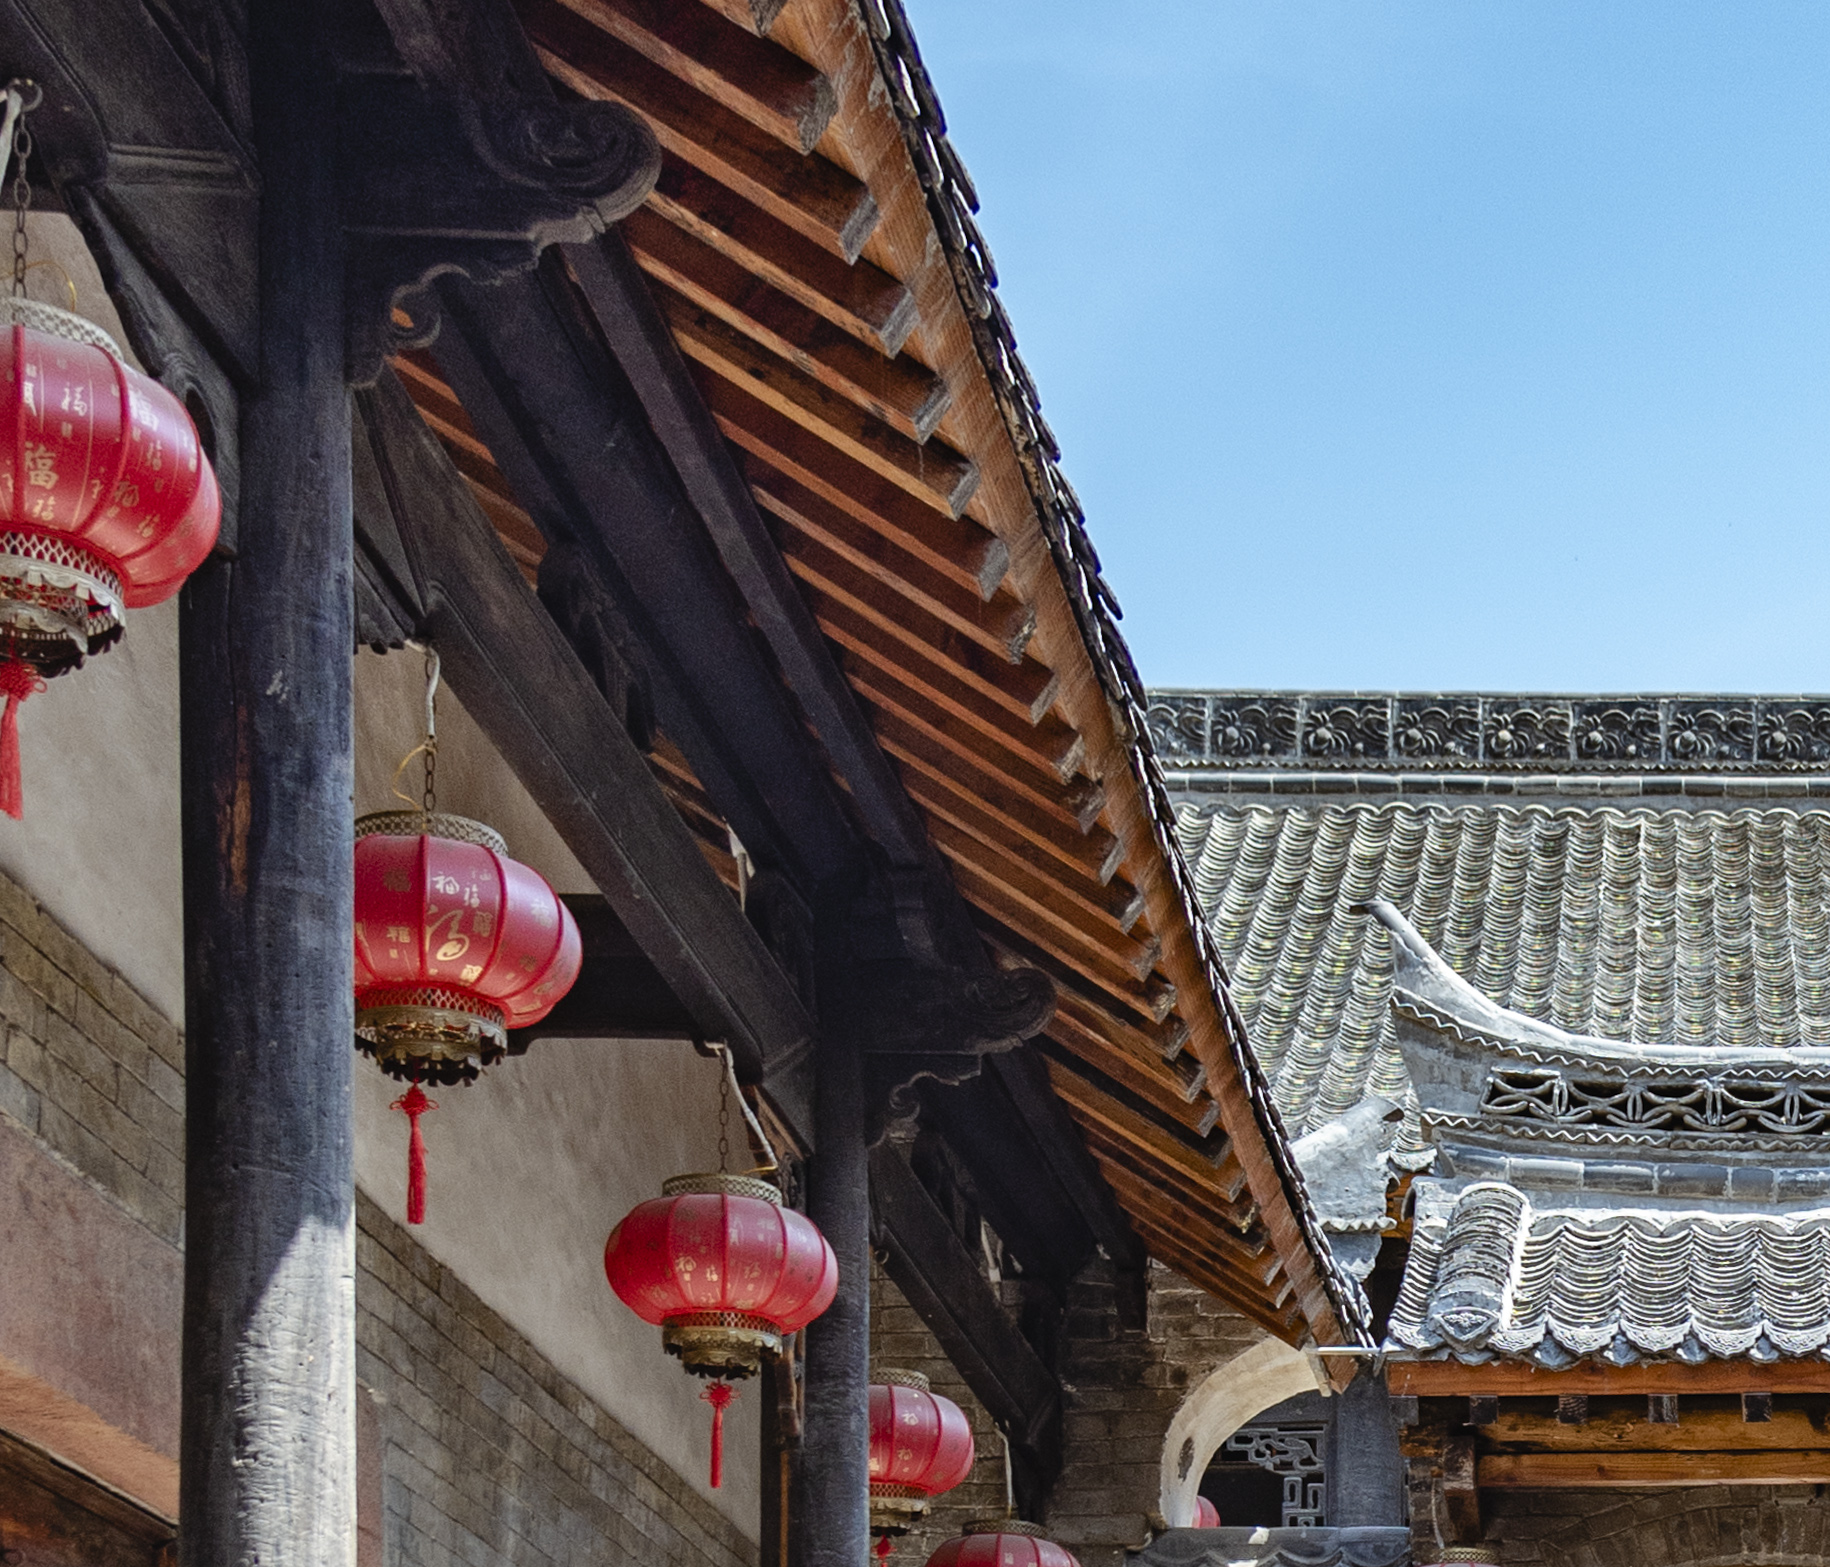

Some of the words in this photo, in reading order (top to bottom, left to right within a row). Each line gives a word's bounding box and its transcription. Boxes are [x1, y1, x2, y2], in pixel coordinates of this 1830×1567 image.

[61, 385, 88, 417] 福
[25, 441, 59, 490] 福
[432, 871, 460, 895] 福
